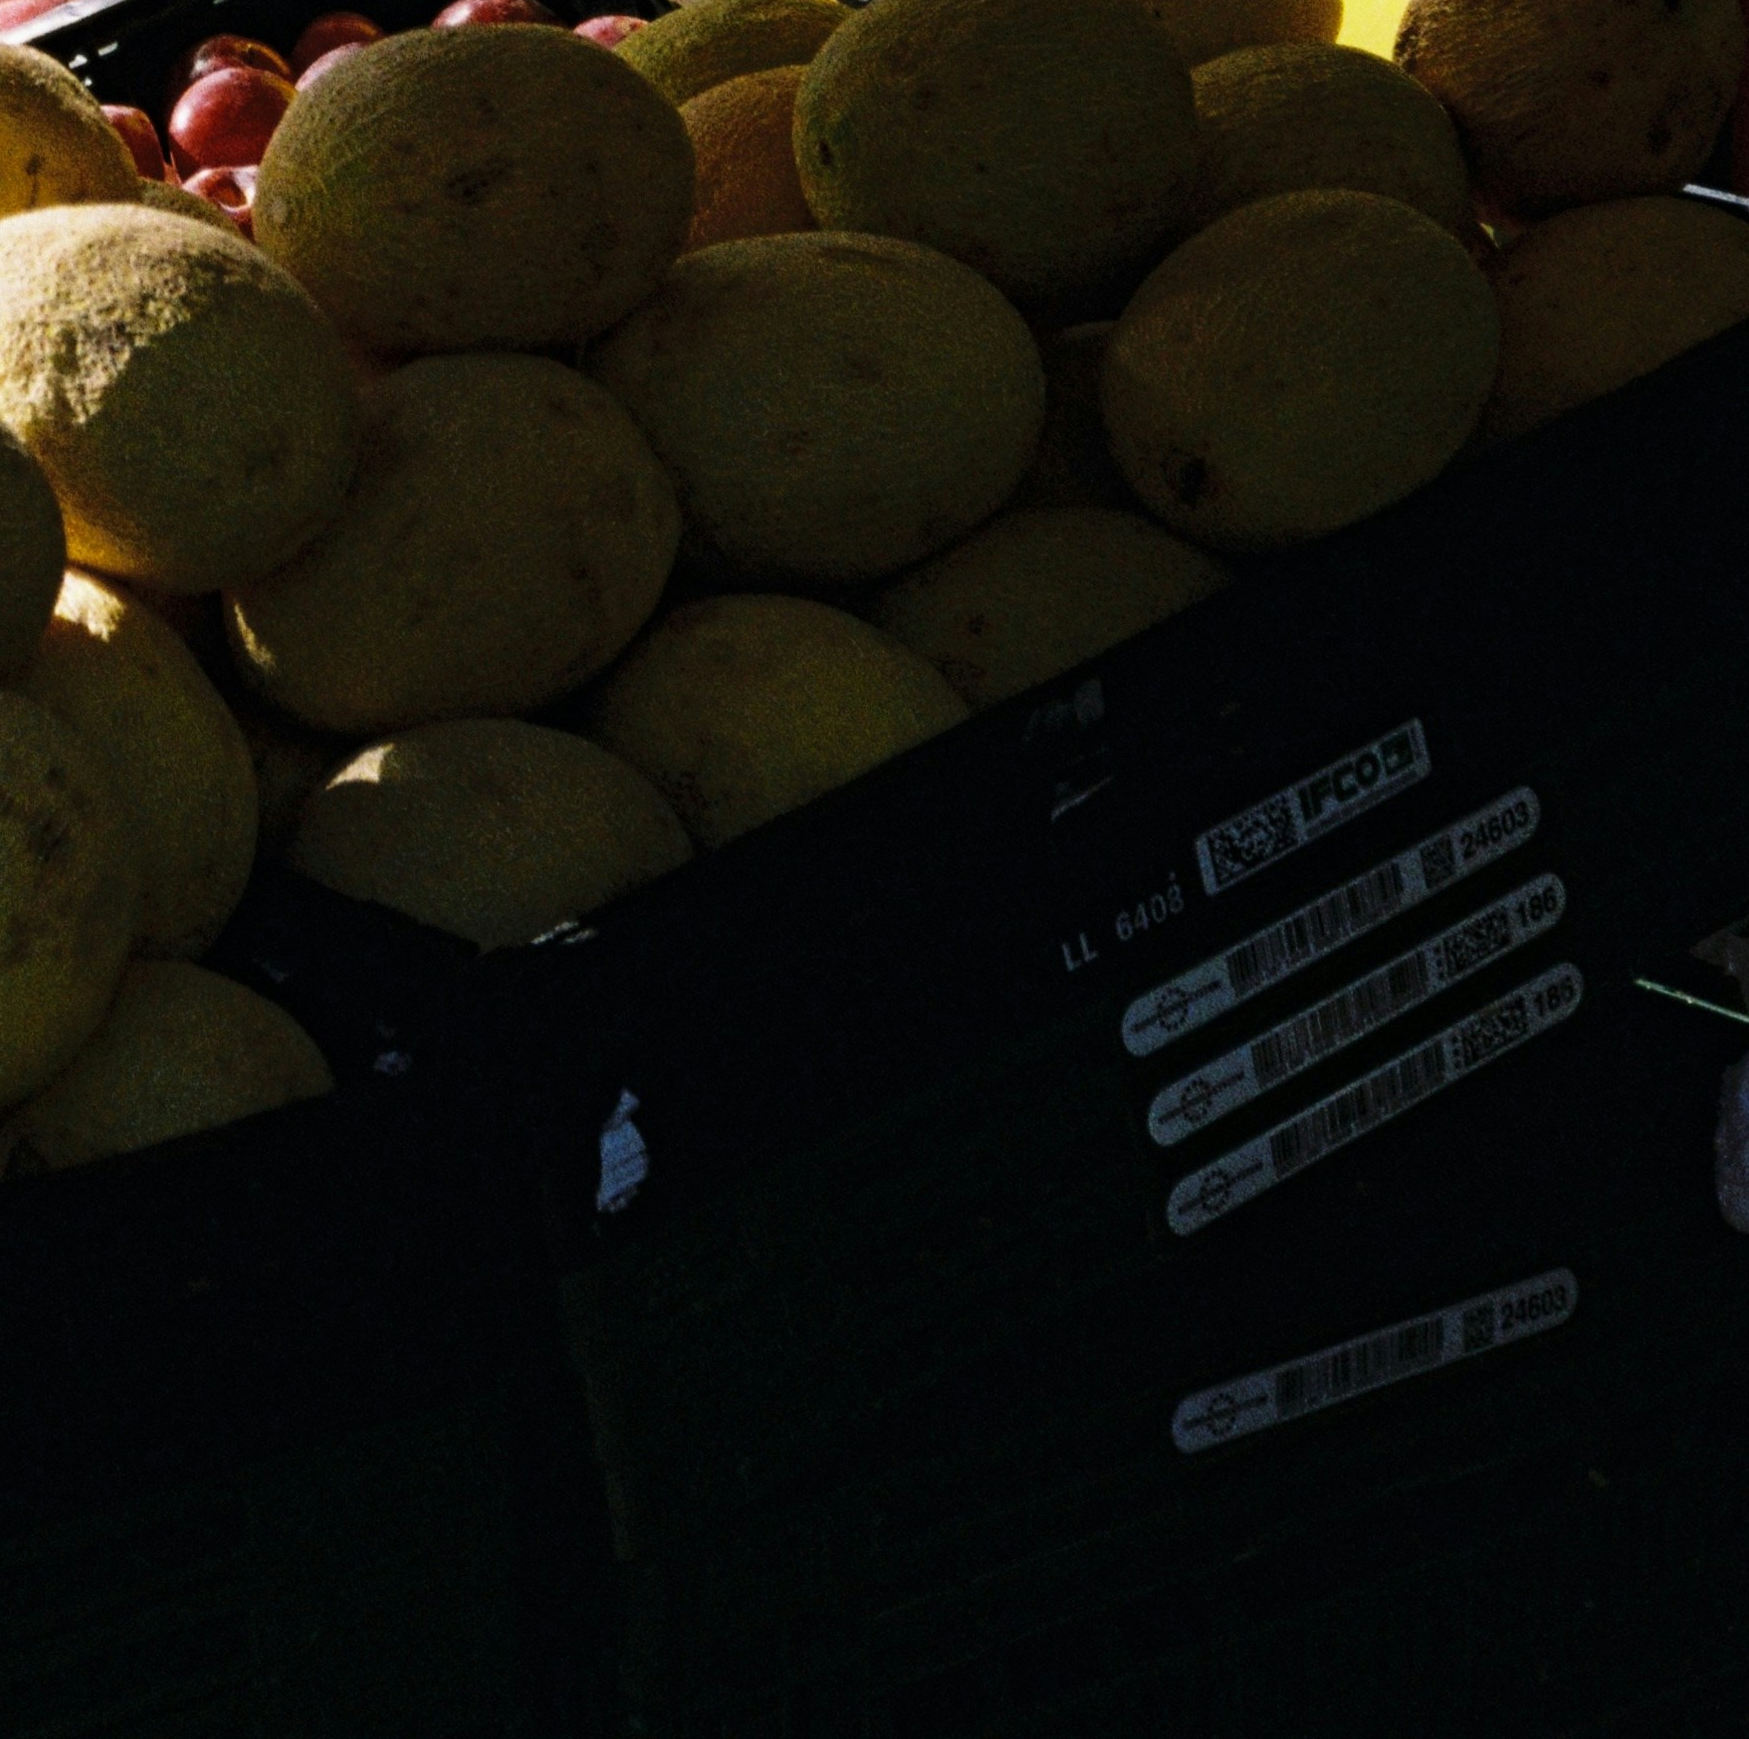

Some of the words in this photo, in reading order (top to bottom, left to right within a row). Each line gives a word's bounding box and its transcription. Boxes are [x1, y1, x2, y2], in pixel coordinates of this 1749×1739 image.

[1297, 753, 1381, 824] IFCO
[1458, 801, 1532, 862] 24603
[1515, 885, 1558, 928] 186
[1499, 1286, 1568, 1331] 24603
